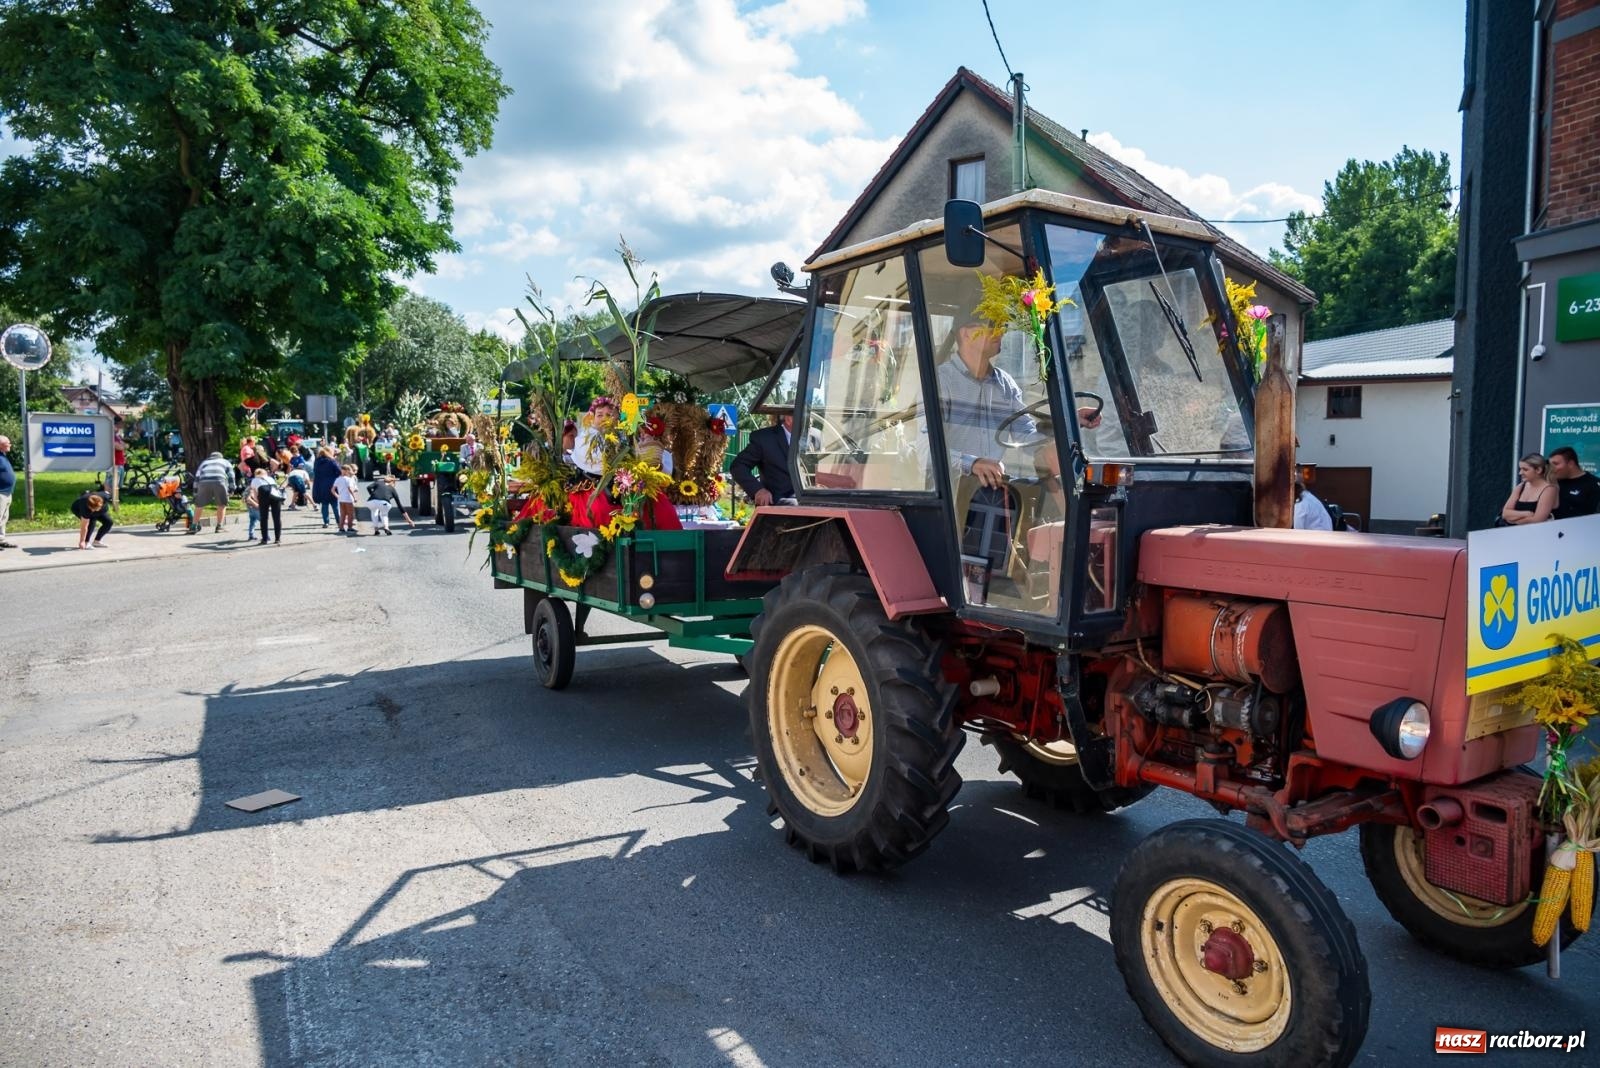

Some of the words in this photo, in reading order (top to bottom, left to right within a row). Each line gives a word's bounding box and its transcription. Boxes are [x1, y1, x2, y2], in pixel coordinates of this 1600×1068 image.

[1568, 297, 1600, 315] 6-23
[1550, 413, 1598, 425] Poprowadź
[45, 426, 92, 435] PARKING
[1562, 426, 1581, 435] sklep
